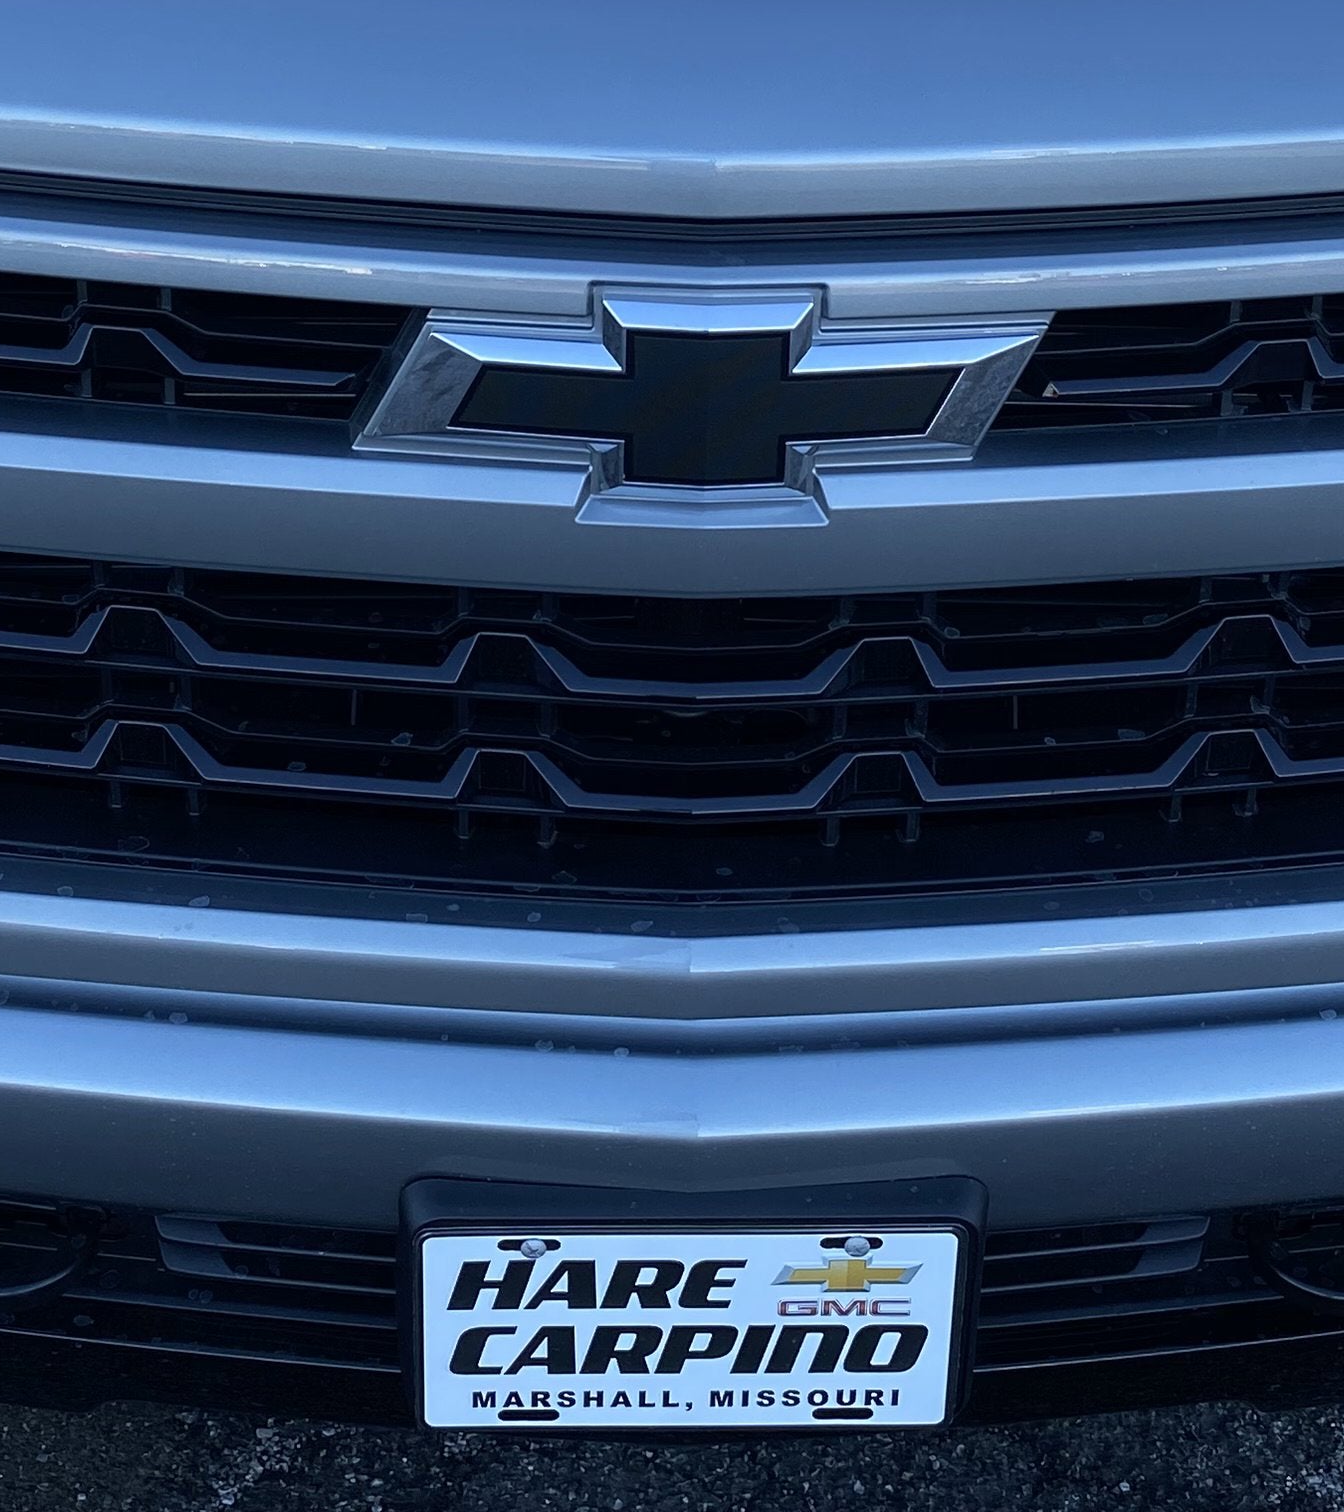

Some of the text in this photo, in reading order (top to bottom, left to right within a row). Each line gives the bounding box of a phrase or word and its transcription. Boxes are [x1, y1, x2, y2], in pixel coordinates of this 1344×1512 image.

[445, 1258, 749, 1311] HARE
[776, 1296, 912, 1318] GMC
[448, 1323, 929, 1376] CARPINO
[471, 1388, 901, 1412] MARSHALL, MISSOURI
